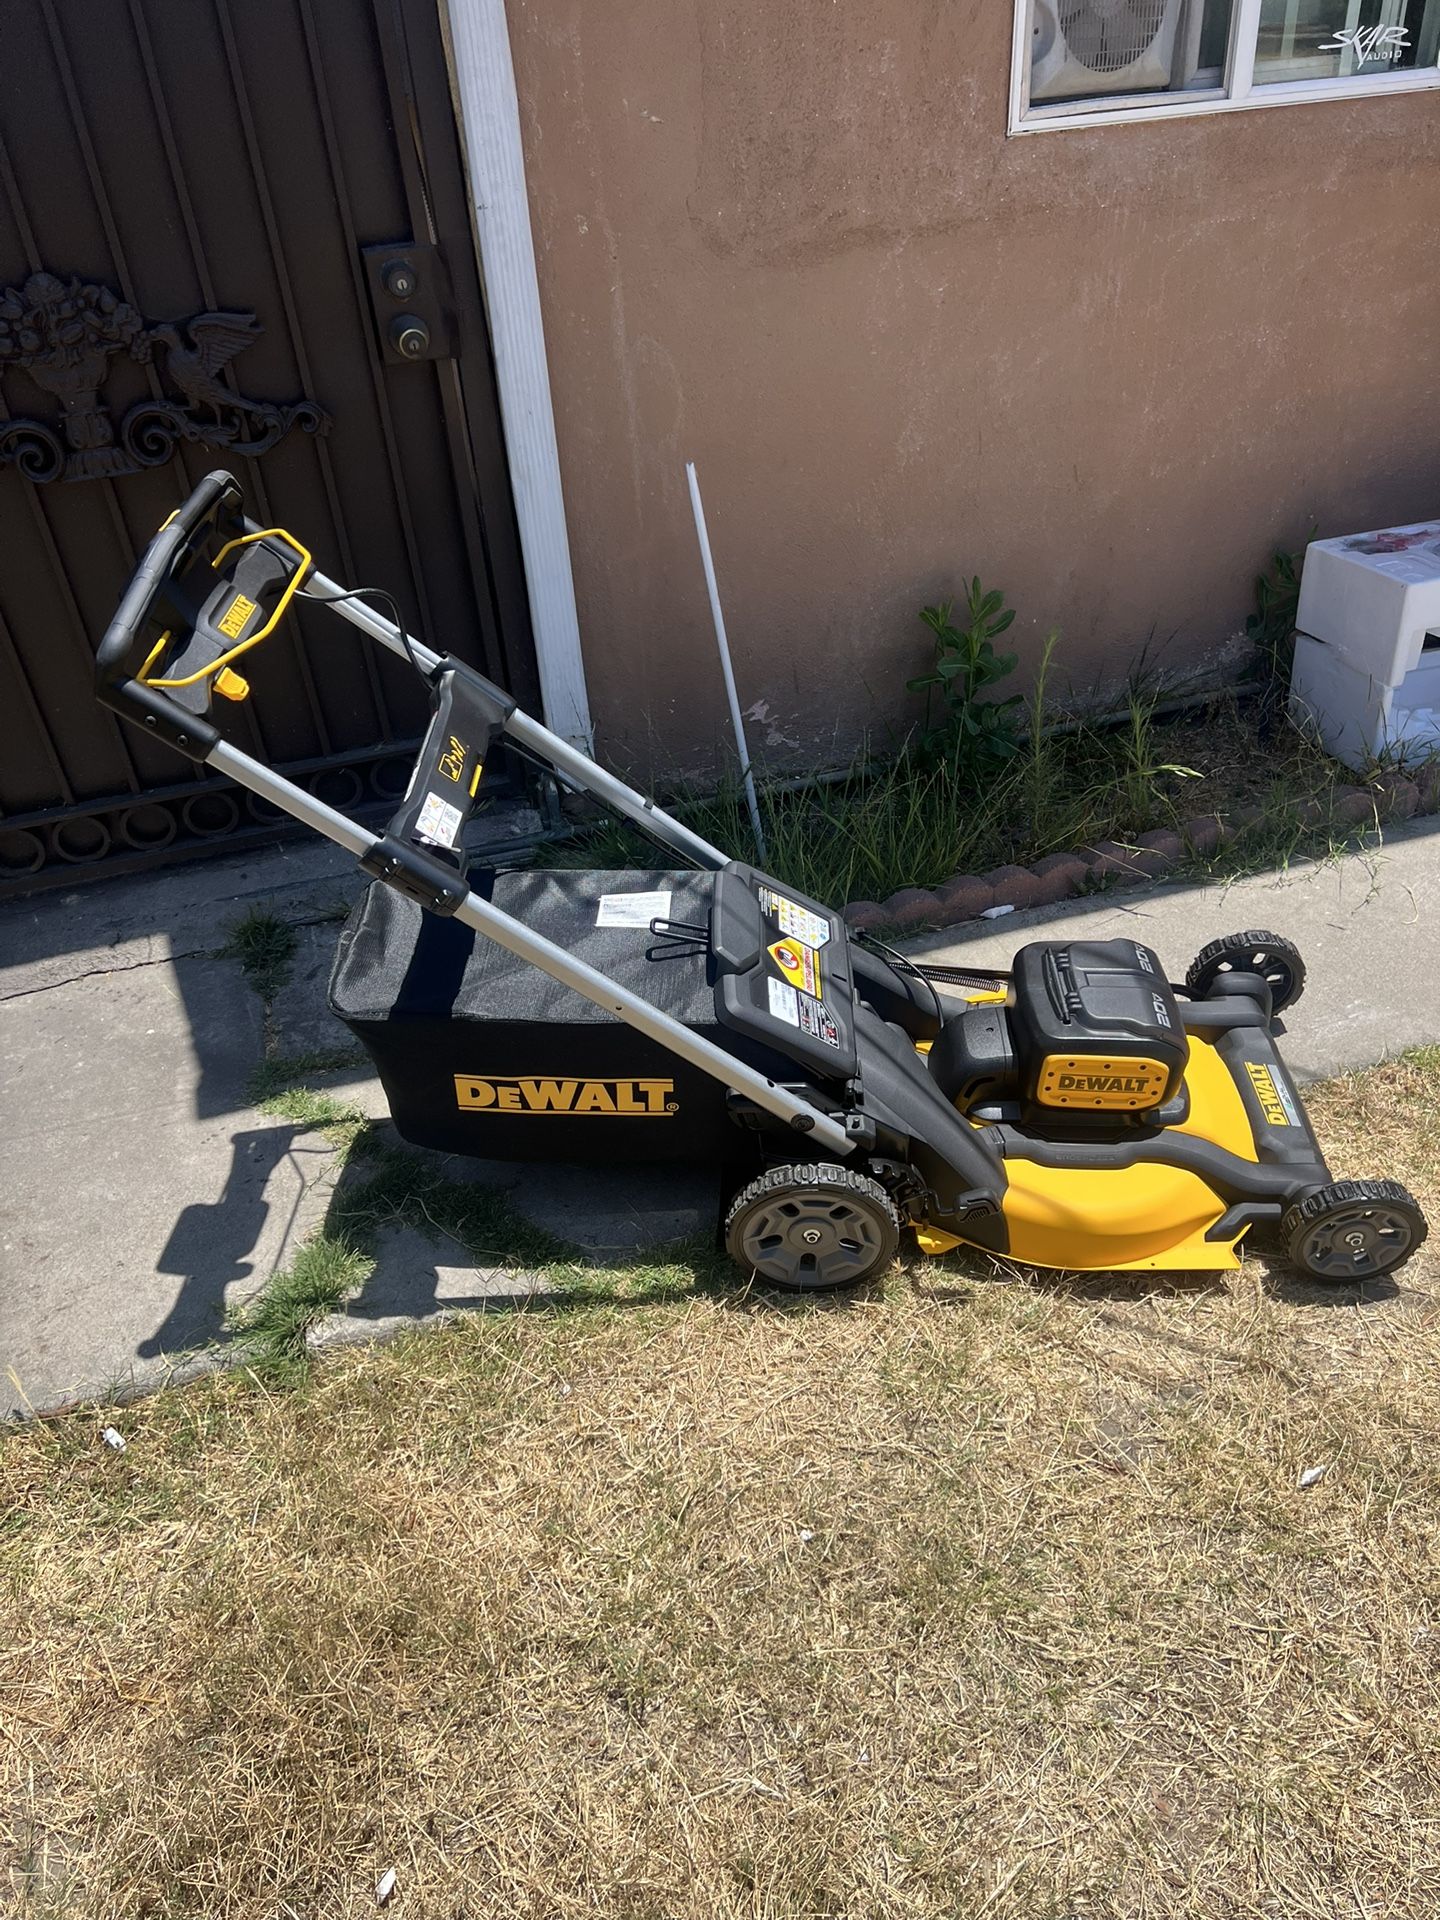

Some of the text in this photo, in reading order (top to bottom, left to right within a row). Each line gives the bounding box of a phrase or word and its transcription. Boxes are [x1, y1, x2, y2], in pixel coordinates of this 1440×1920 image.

[1318, 24, 1411, 70] SKAR
[1366, 50, 1402, 61] AUDIO
[1133, 943, 1155, 974] 20V
[1152, 992, 1171, 1028] 20V
[1058, 1075, 1149, 1092] DEWALT
[1246, 1062, 1288, 1126] DEWALT
